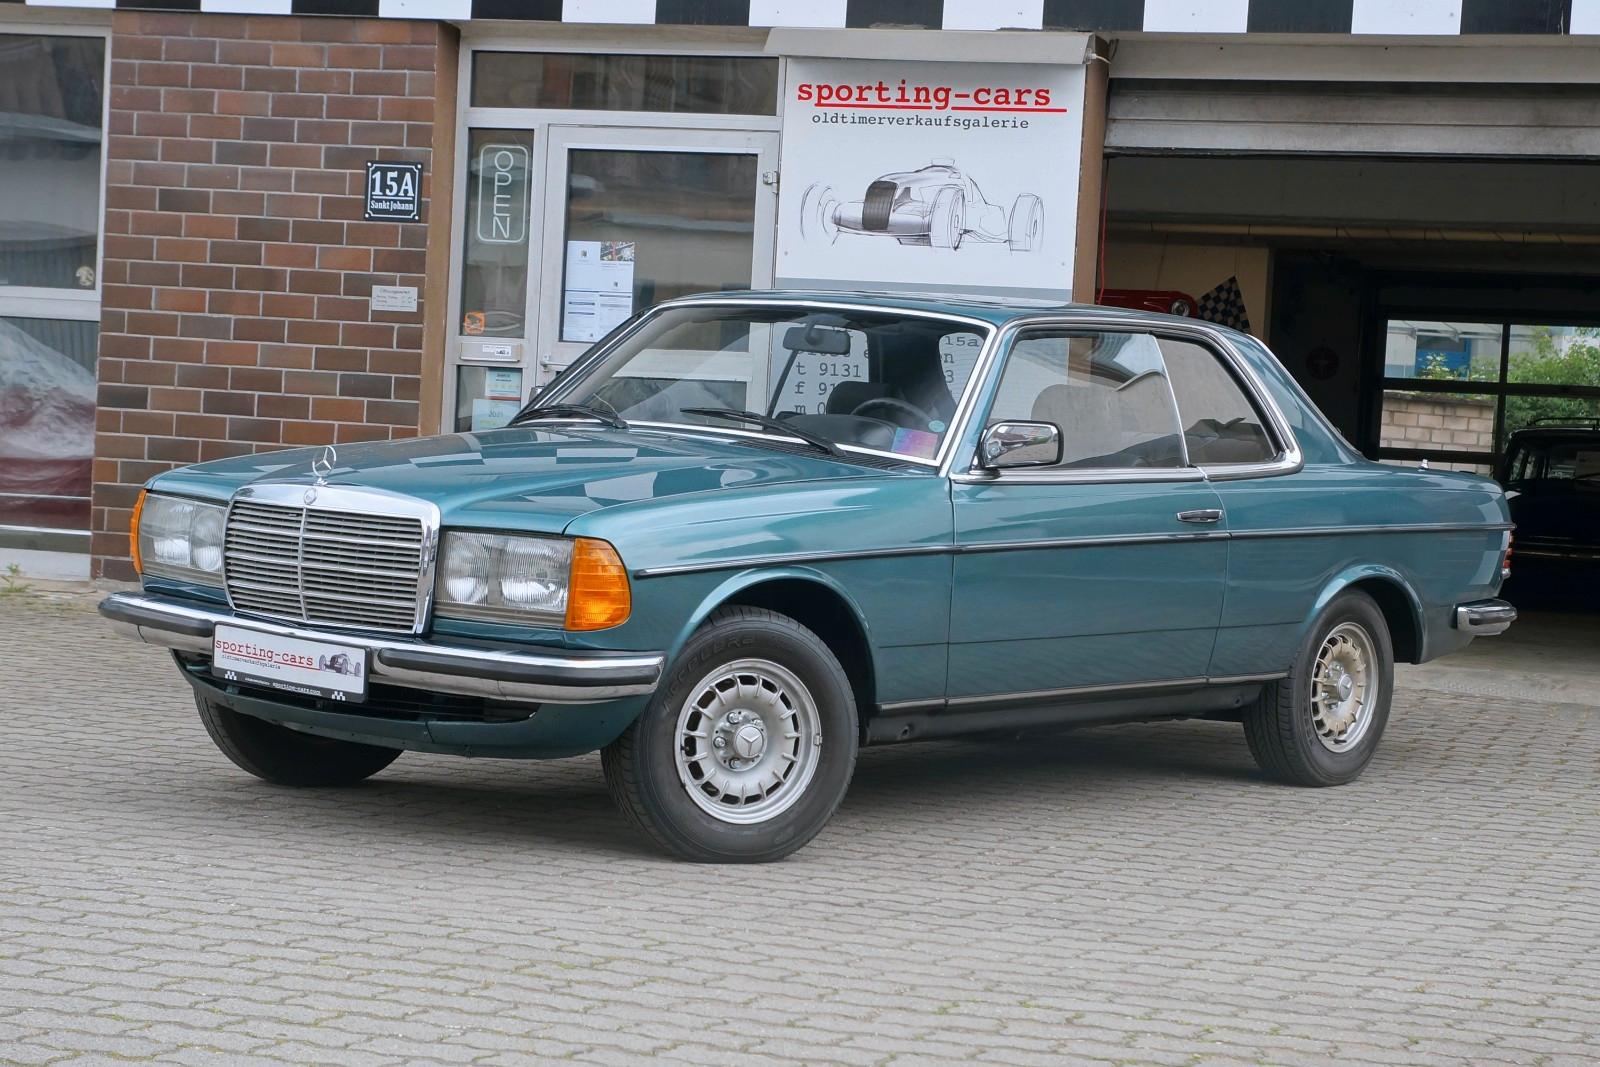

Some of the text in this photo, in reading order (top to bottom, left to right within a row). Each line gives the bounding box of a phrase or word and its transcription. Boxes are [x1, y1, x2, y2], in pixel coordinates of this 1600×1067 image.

[797, 79, 1051, 111] sporting-cars
[811, 113, 1029, 130] oldtimerverkaufsgalerie
[371, 170, 415, 197] 15A
[492, 150, 514, 238] OPEN
[370, 200, 414, 211] Sankt Johann
[819, 362, 861, 378] 9131
[215, 639, 314, 666] sporting-cars
